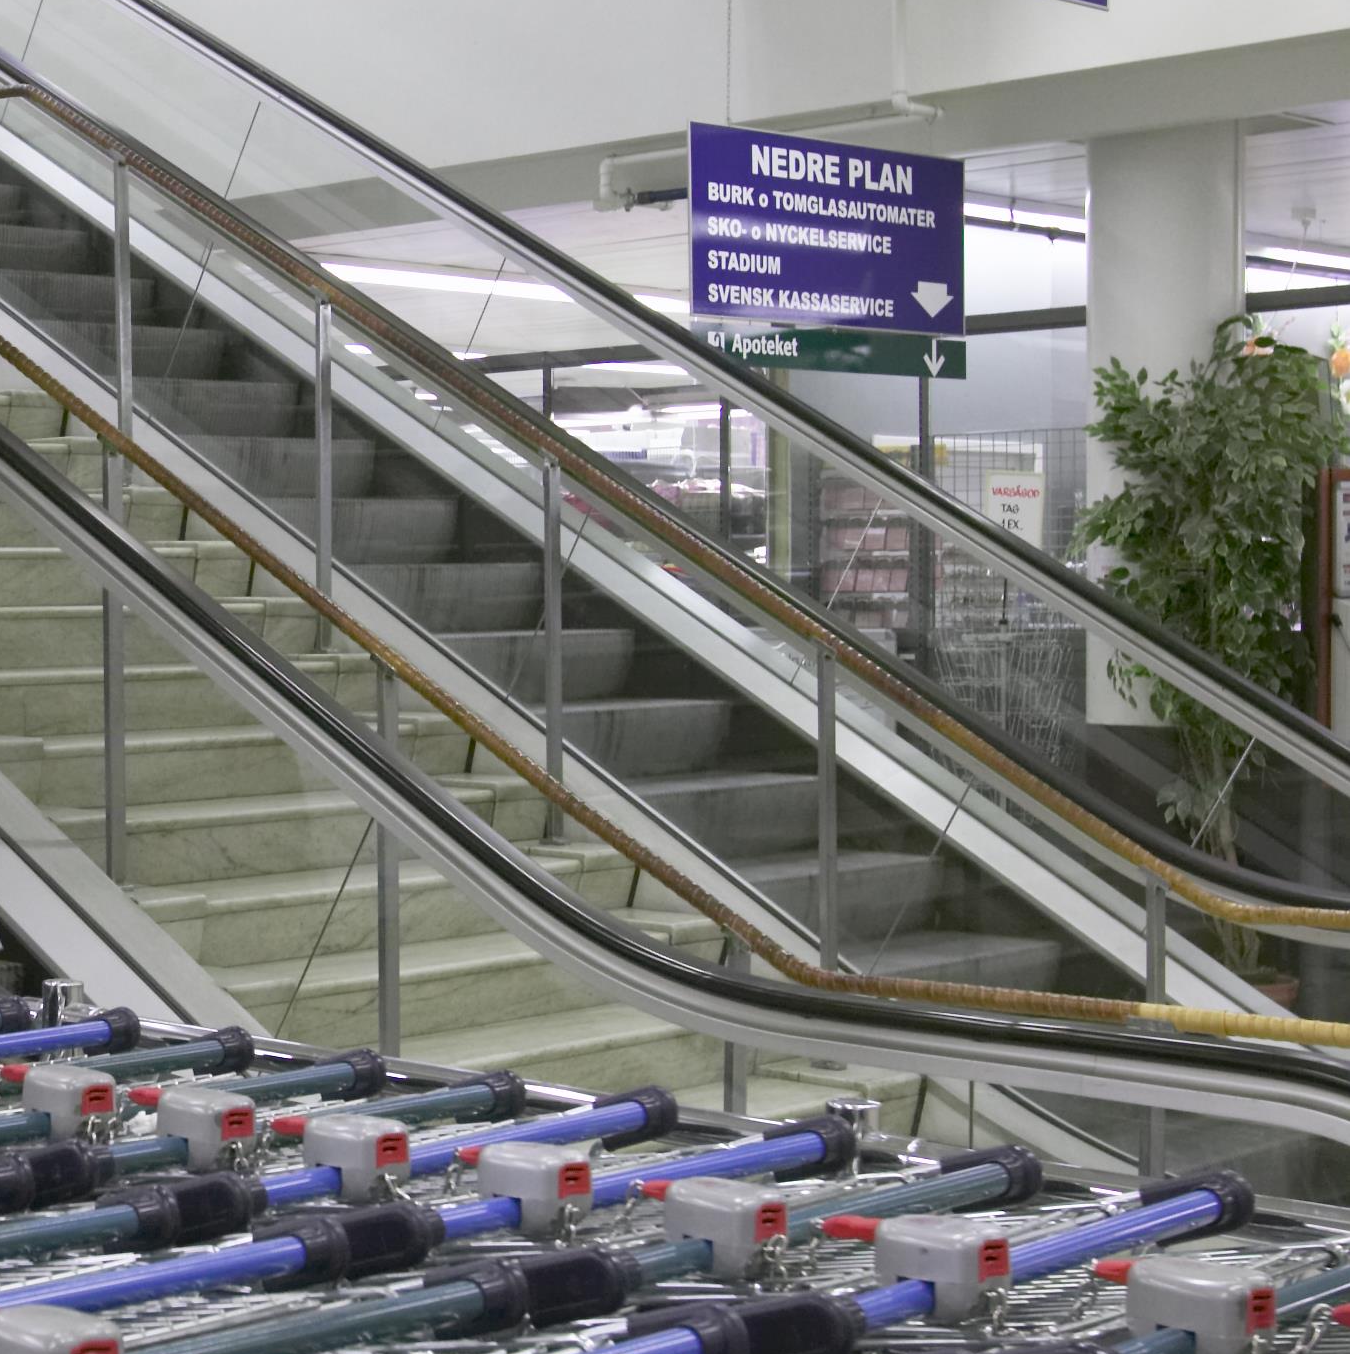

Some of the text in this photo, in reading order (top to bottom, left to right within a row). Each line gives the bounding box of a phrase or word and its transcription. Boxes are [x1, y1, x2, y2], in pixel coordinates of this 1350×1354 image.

[751, 144, 913, 195] NEDRE PLAN
[707, 181, 936, 229] BURK o TOMGLASAUTOMATER
[707, 216, 892, 255] SKO- o NYCKELSERVICE
[707, 249, 781, 276] STADIUM
[707, 283, 894, 318] SVENSK KASSASERVICE
[731, 332, 798, 360] Apoteket
